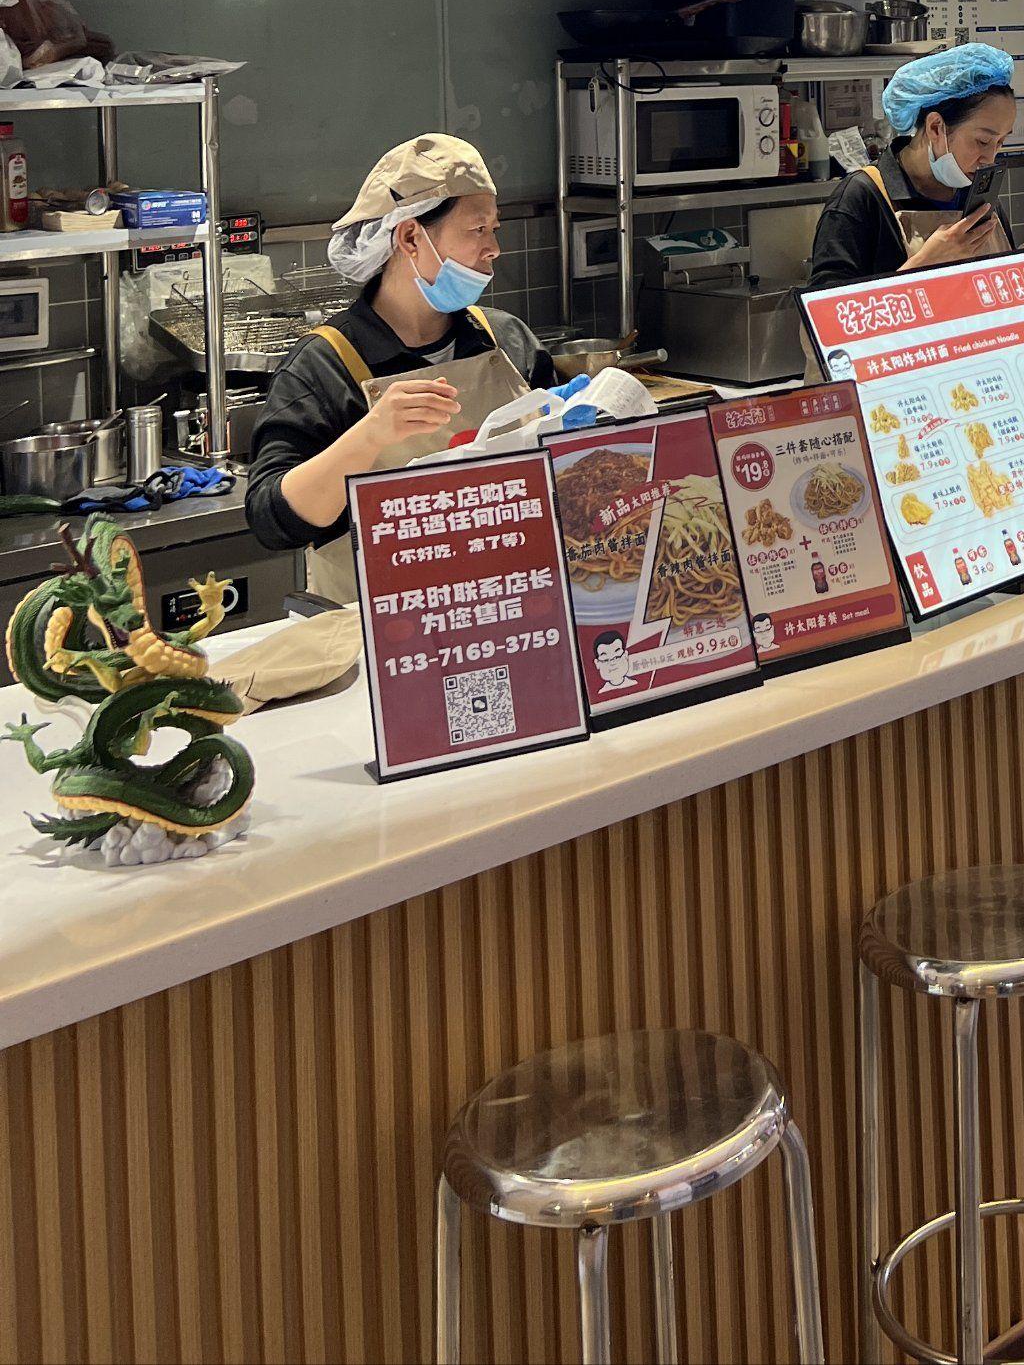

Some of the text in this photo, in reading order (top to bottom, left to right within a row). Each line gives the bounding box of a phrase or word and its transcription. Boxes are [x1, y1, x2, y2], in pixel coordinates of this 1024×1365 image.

[836, 293, 916, 335] 许太阳
[866, 332, 1020, 375] 许太阳炸鸡拌面 Fried chicken Noodle
[776, 431, 855, 456] 三件套随心搭配
[380, 478, 527, 519] 如在本店购买
[599, 481, 671, 526] 新品 太阳推荐
[371, 498, 543, 544] 产品遇任何问题
[566, 531, 647, 562] 番茄肉酱拌面
[657, 548, 731, 578] 香辣肉酱拌面
[373, 567, 553, 615] 可及时联系店长
[421, 597, 523, 635] 为您售后
[784, 611, 838, 636] 许太阳套餐
[842, 613, 853, 621] Set
[385, 628, 560, 677] 133-7169-3759
